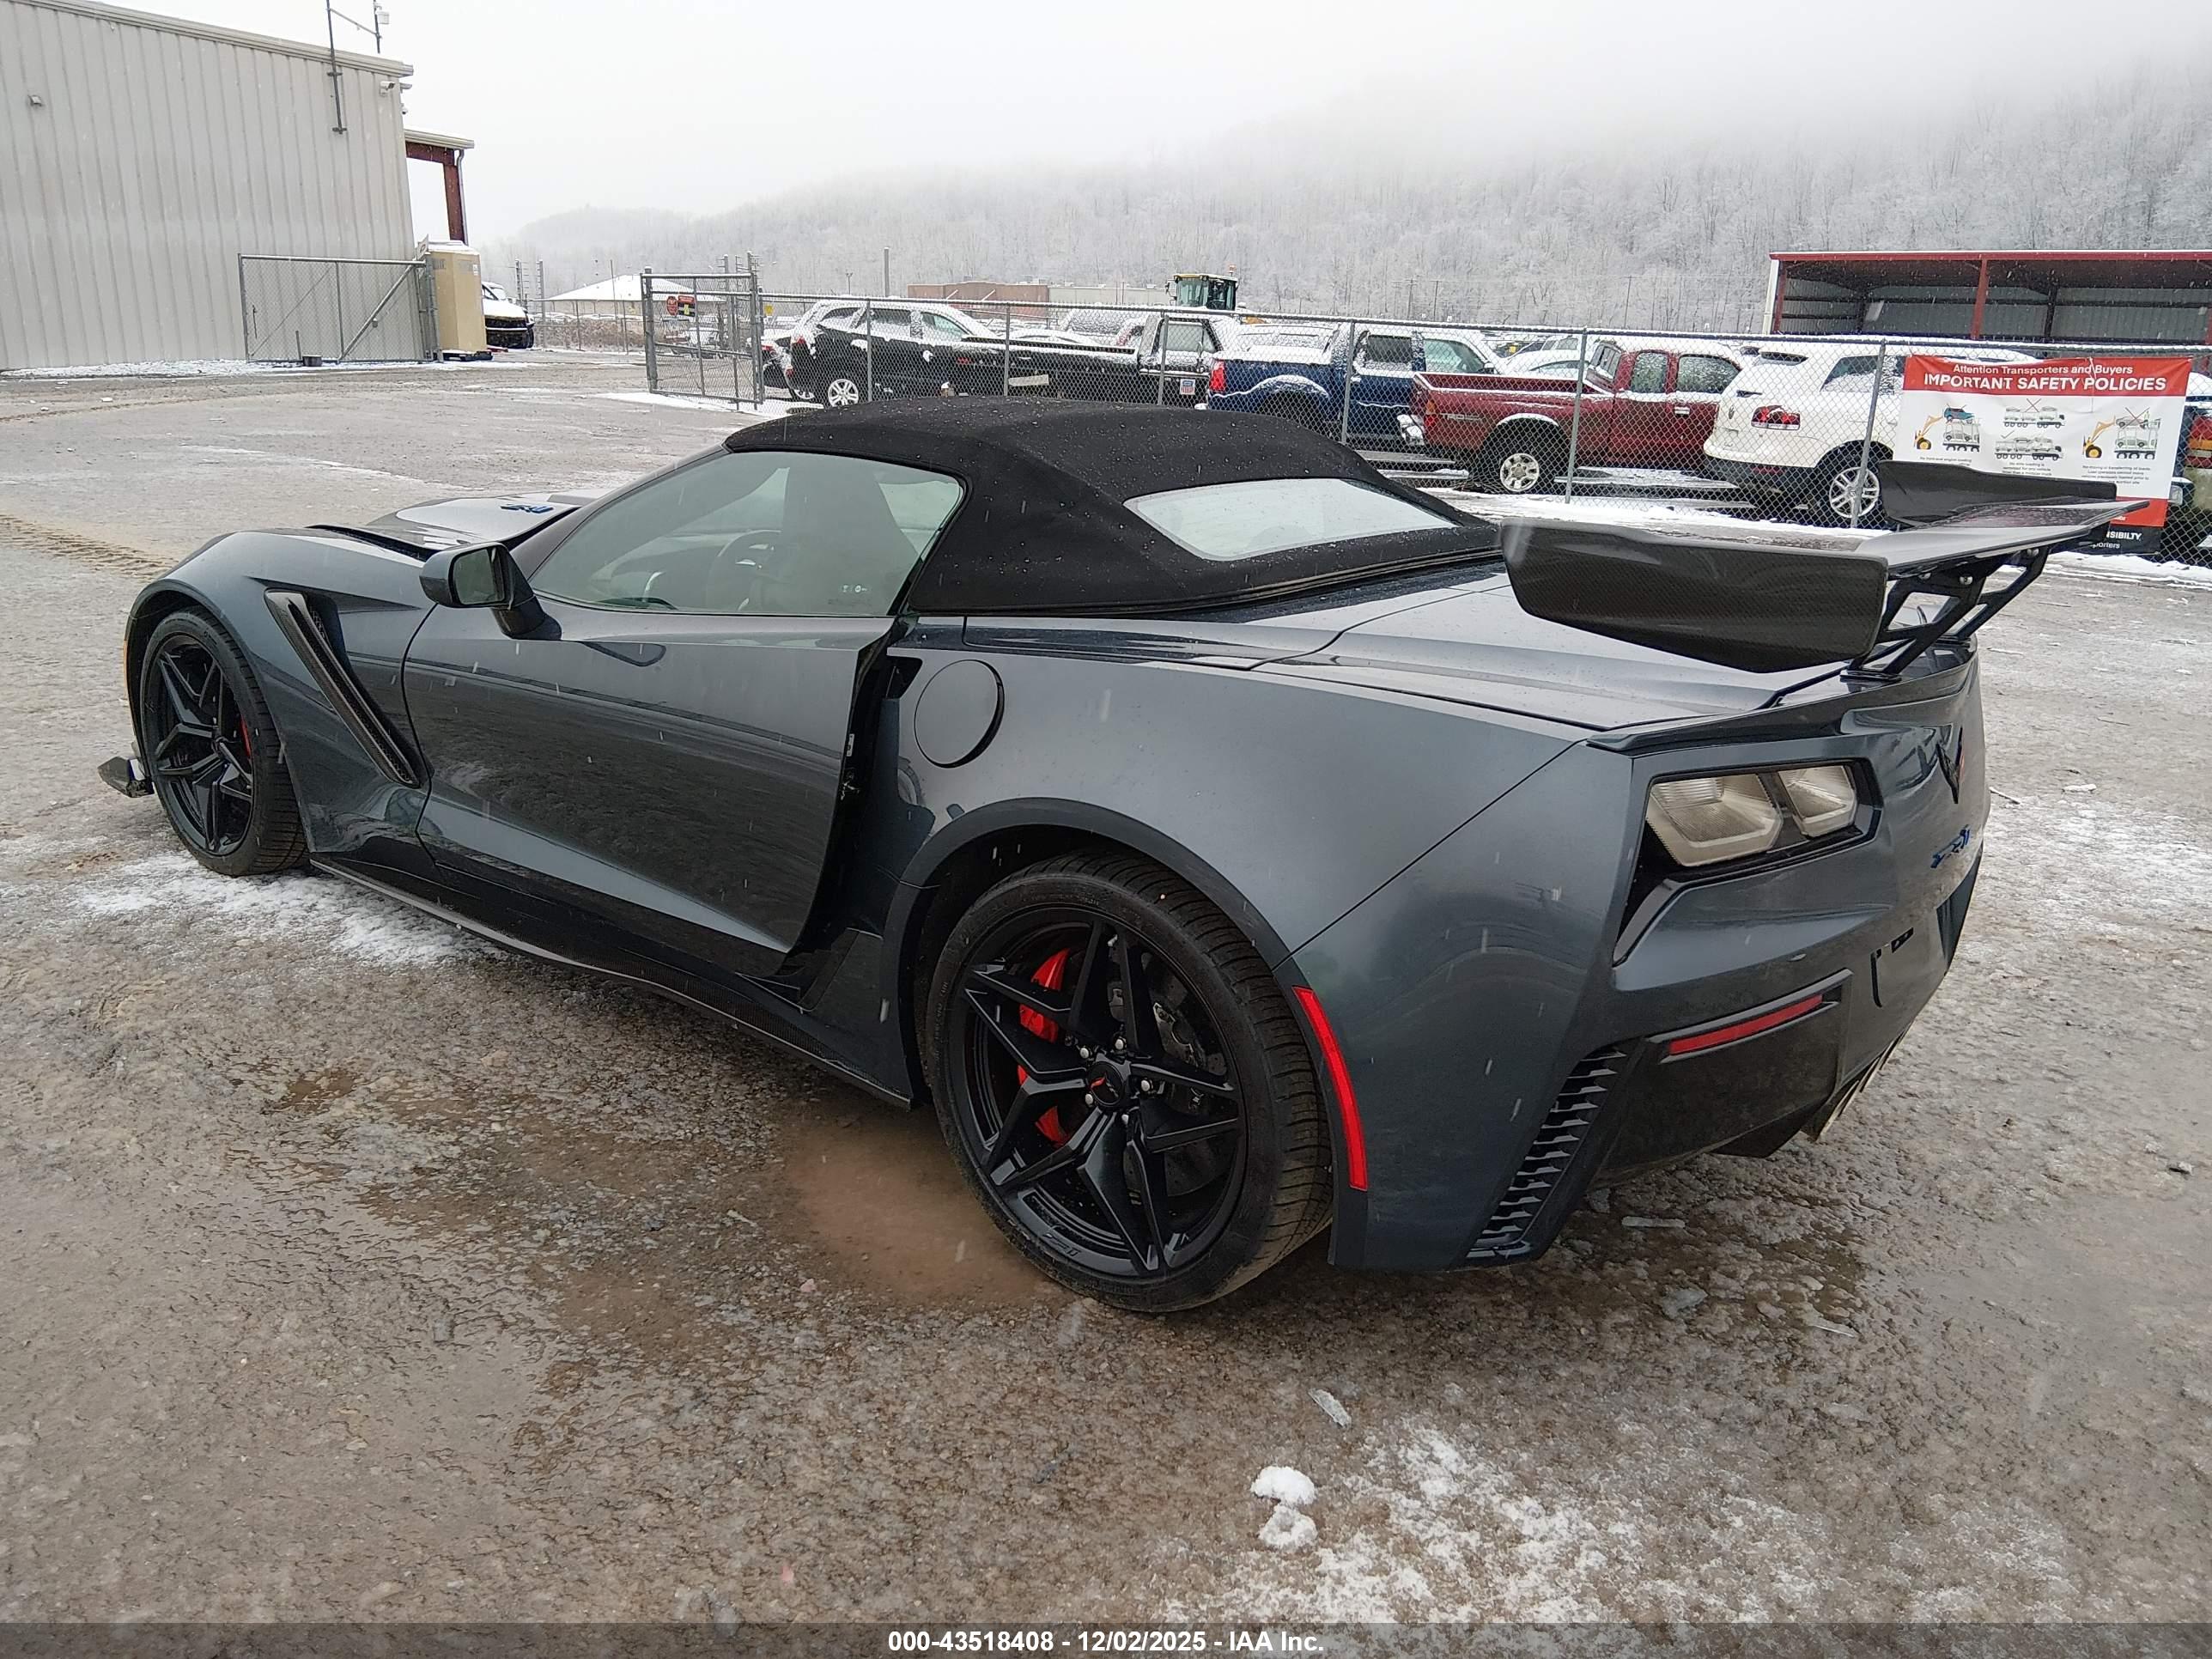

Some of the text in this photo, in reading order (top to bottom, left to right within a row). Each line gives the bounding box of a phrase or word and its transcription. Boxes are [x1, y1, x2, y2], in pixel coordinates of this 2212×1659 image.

[1954, 364, 2133, 376] Attention Transporters and Buyers
[1924, 374, 2166, 391] IMPORTANT SAFETY POLICIES
